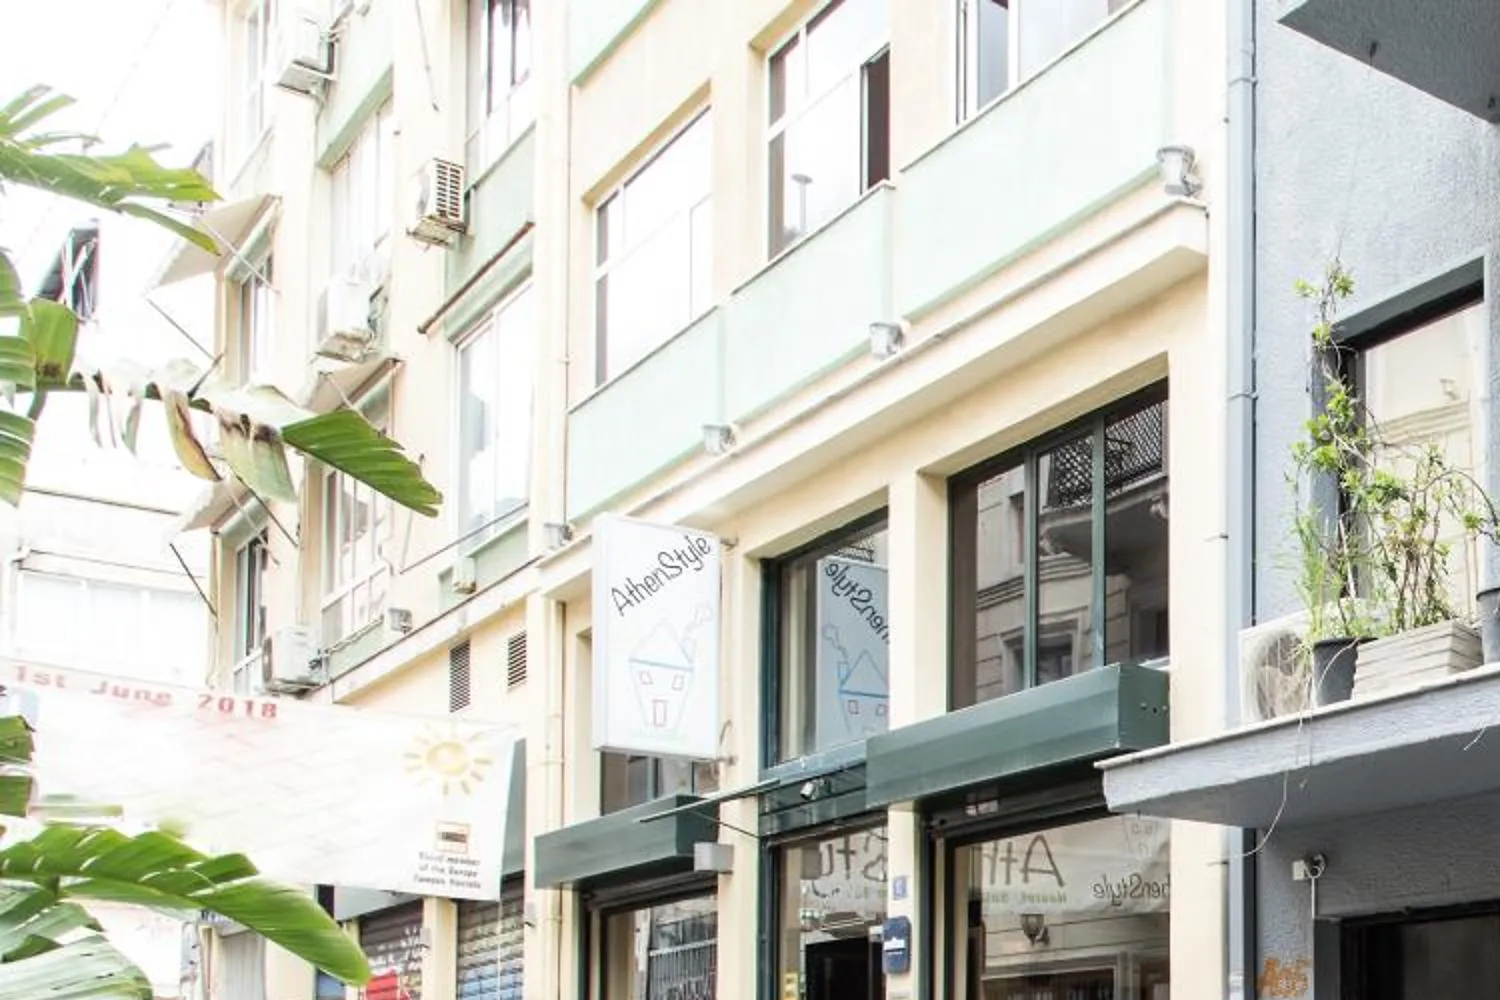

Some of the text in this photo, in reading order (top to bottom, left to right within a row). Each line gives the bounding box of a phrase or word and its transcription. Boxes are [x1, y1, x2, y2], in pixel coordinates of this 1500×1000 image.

[611, 535, 711, 617] AthenStyle
[14, 664, 278, 719] 1st June 2018
